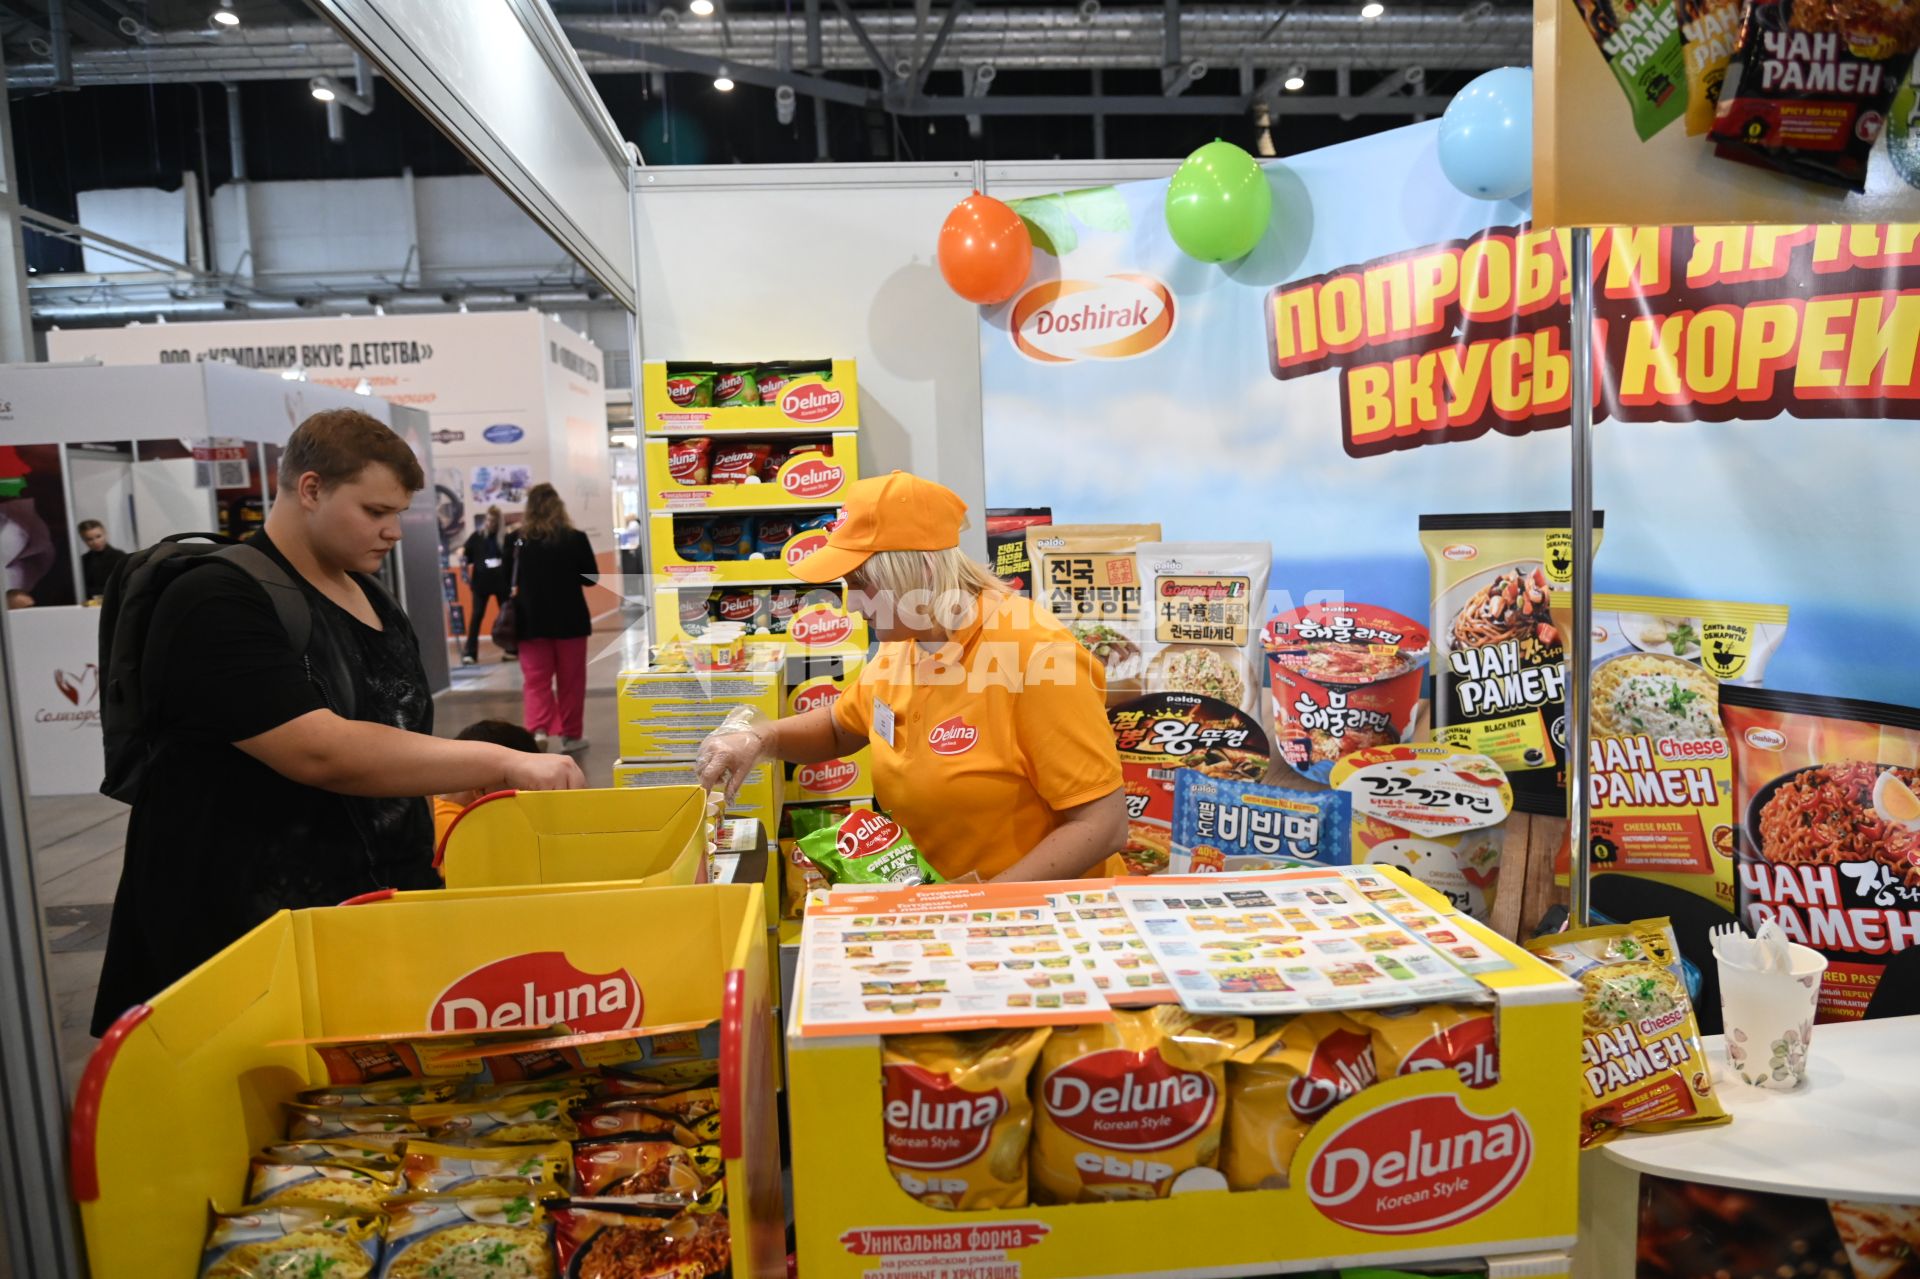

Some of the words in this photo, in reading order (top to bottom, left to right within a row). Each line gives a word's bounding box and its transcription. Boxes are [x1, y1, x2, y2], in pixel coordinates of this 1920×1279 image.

[1603, 3, 1655, 55] ЧАН
[1764, 31, 1837, 61] ЧАН
[1762, 61, 1884, 94] РАМЕН
[1035, 299, 1147, 335] Doshirak
[302, 344, 344, 367] ВКУС
[784, 389, 840, 413] Deluna
[784, 467, 841, 491] Deluna
[1037, 538, 1065, 550] paldo
[1051, 559, 1094, 585] 진국
[1154, 560, 1182, 573] paldo
[720, 597, 760, 614] Deluna
[794, 616, 850, 639] Deluna
[1170, 623, 1234, 641] 진국곰파게티
[1293, 616, 1404, 645] 해물라면
[1450, 641, 1519, 679] ЧАН
[1166, 695, 1203, 705] paldo
[1458, 664, 1565, 713] РАМЕН
[1293, 692, 1390, 737] 해물라면
[929, 725, 976, 744] Deluna
[1151, 719, 1250, 756] 왕뚜껑
[1484, 724, 1506, 734] BLACK
[1751, 734, 1780, 745] Doshirak
[1659, 738, 1724, 757] Cheese
[800, 761, 856, 786] Deluna
[1591, 768, 1716, 806] РАМЕН
[1191, 783, 1217, 795] paldo
[1360, 776, 1493, 814] 꼬꼬면
[1196, 801, 1216, 838] 팔도
[1217, 802, 1320, 860] 비빔면
[1623, 823, 1655, 832] CHEESE
[1656, 823, 1683, 832] PASTA
[866, 843, 917, 872] СМЕТАНА
[1739, 865, 1837, 905] ЧАН
[1823, 971, 1847, 982] RED
[440, 977, 627, 1033] Deluna
[1641, 1008, 1682, 1036] Cheese
[1585, 1033, 1689, 1098] РАМЕН
[1048, 1072, 1204, 1119] Deluna
[1623, 1093, 1649, 1109] CHEESE
[886, 1089, 999, 1131] eluna
[1093, 1119, 1138, 1131] Korean
[1141, 1114, 1171, 1130] Style
[888, 1133, 928, 1148] Korean
[931, 1132, 961, 1150] Style
[1311, 1124, 1515, 1206] Deluna
[1375, 1188, 1430, 1213] Korean
[1433, 1176, 1470, 1198] Style
[860, 1231, 962, 1255] Уникальная
[968, 1227, 1022, 1250] форма
[881, 1259, 895, 1268] на
[898, 1256, 967, 1269] российском
[969, 1253, 1005, 1265] рынке
[941, 1268, 948, 1277] И
[952, 1264, 1020, 1279] ХРУСТЯЩИЕ
